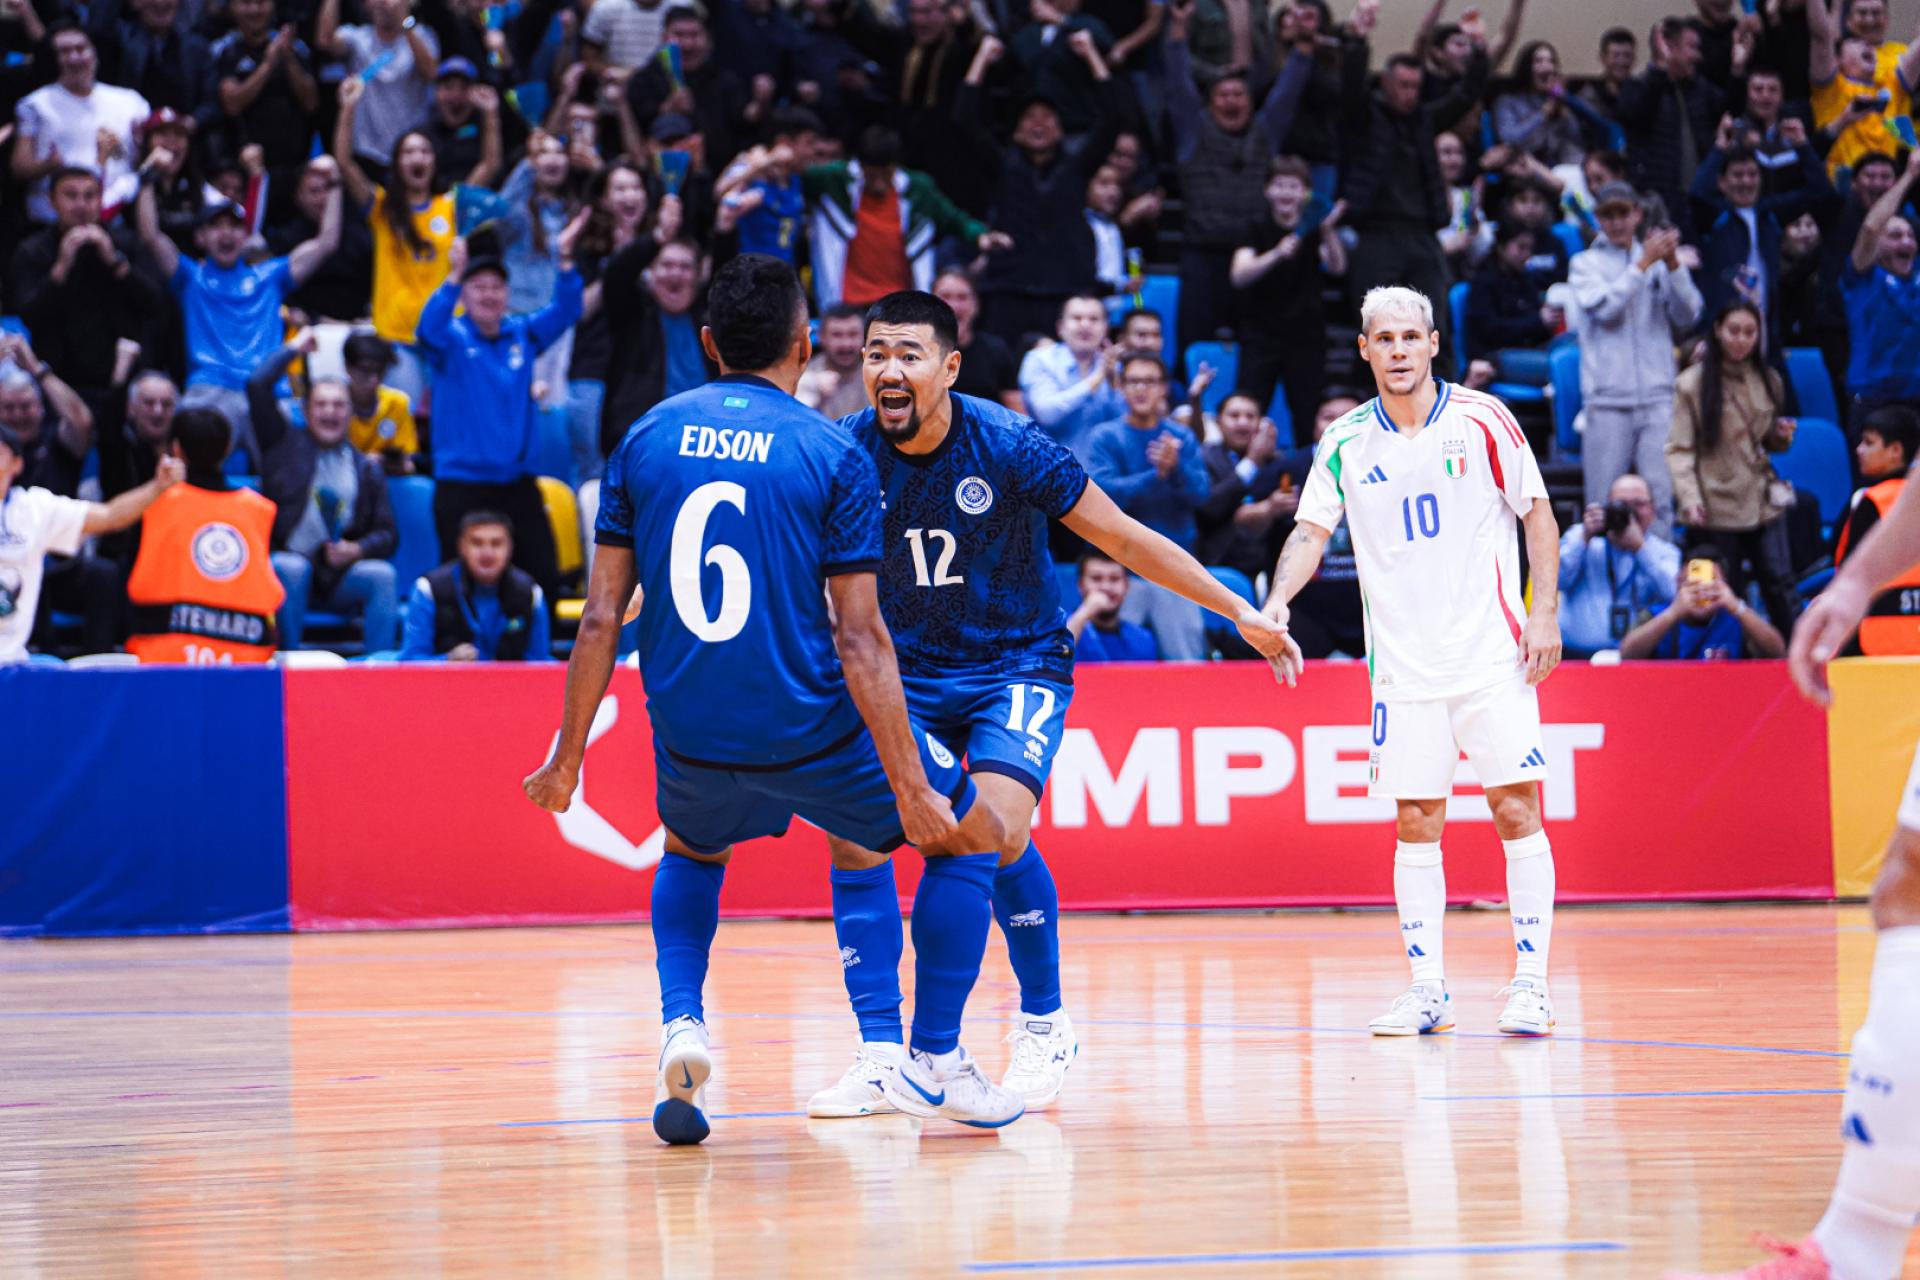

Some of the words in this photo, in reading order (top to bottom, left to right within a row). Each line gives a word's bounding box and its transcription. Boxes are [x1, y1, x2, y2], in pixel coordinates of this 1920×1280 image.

[679, 424, 775, 463] EDSON
[1402, 493, 1440, 541] 10
[669, 480, 752, 643] 6
[904, 528, 964, 586] 12
[1006, 683, 1055, 746] 12
